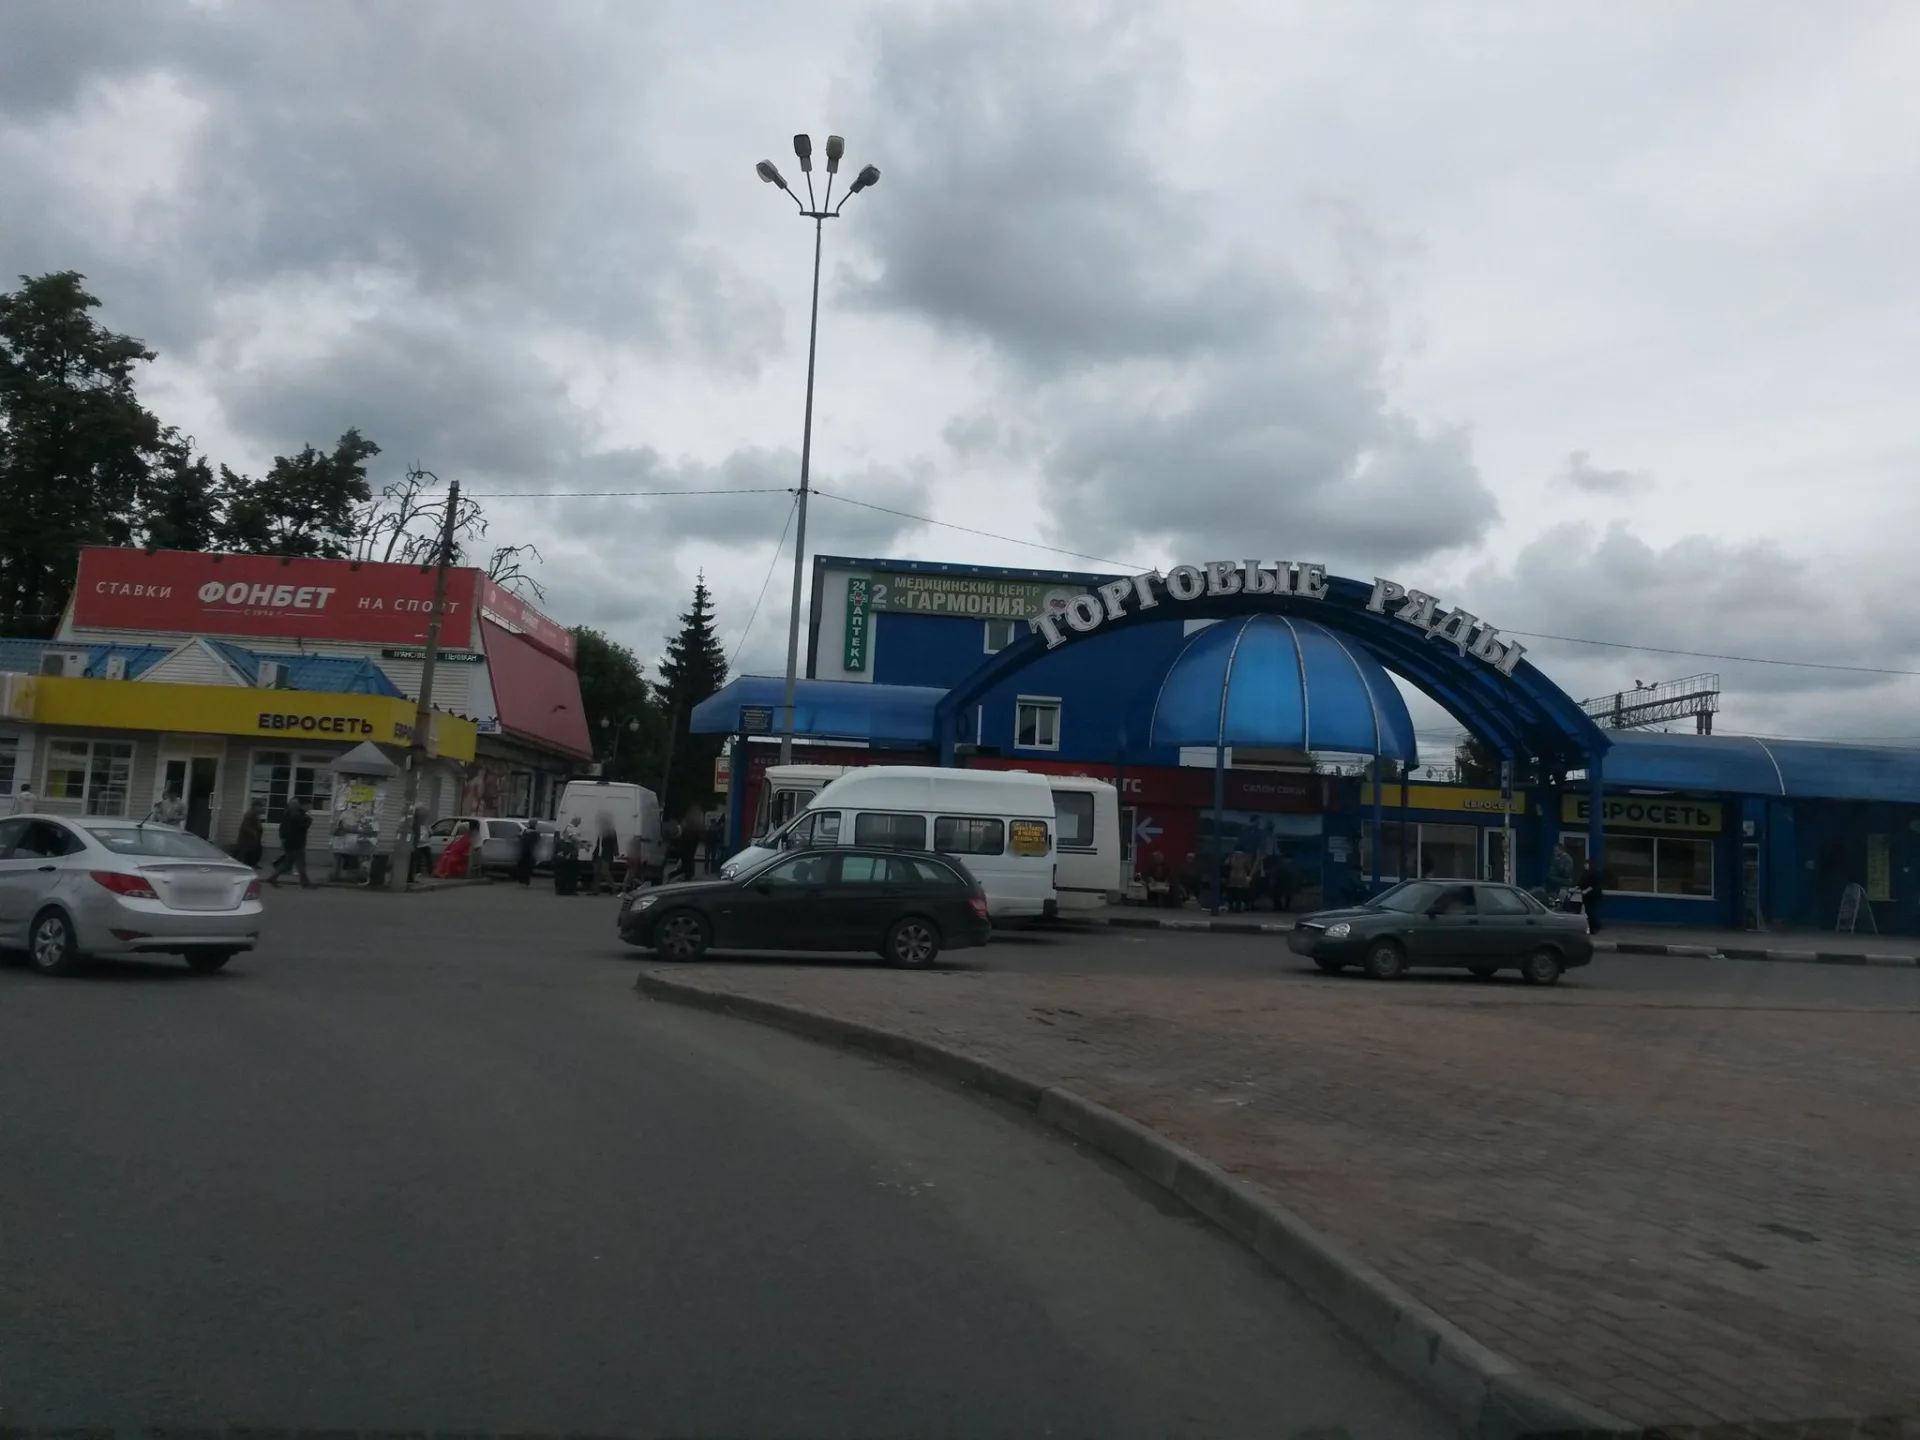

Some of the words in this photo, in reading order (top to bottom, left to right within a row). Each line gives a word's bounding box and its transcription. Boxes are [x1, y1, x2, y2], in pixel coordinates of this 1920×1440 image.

[95, 581, 172, 599] СТАВКИ
[197, 580, 336, 609] ФОНБЕТ
[853, 581, 867, 591] 24
[871, 584, 888, 604] 2
[894, 577, 995, 593] МЕДИЦИНСКИЙ
[999, 584, 1041, 597] ЦЕНТР
[358, 597, 384, 610] НА
[394, 598, 460, 614] СПОТ
[1030, 558, 1329, 650] ТОРГОВЫЕ
[1365, 577, 1529, 678] РЯДЫ
[849, 606, 864, 669] АПТЕКА
[258, 713, 374, 734] ЕВРОСЕТЬ
[1463, 798, 1518, 812] ЕВРОСЕЬ
